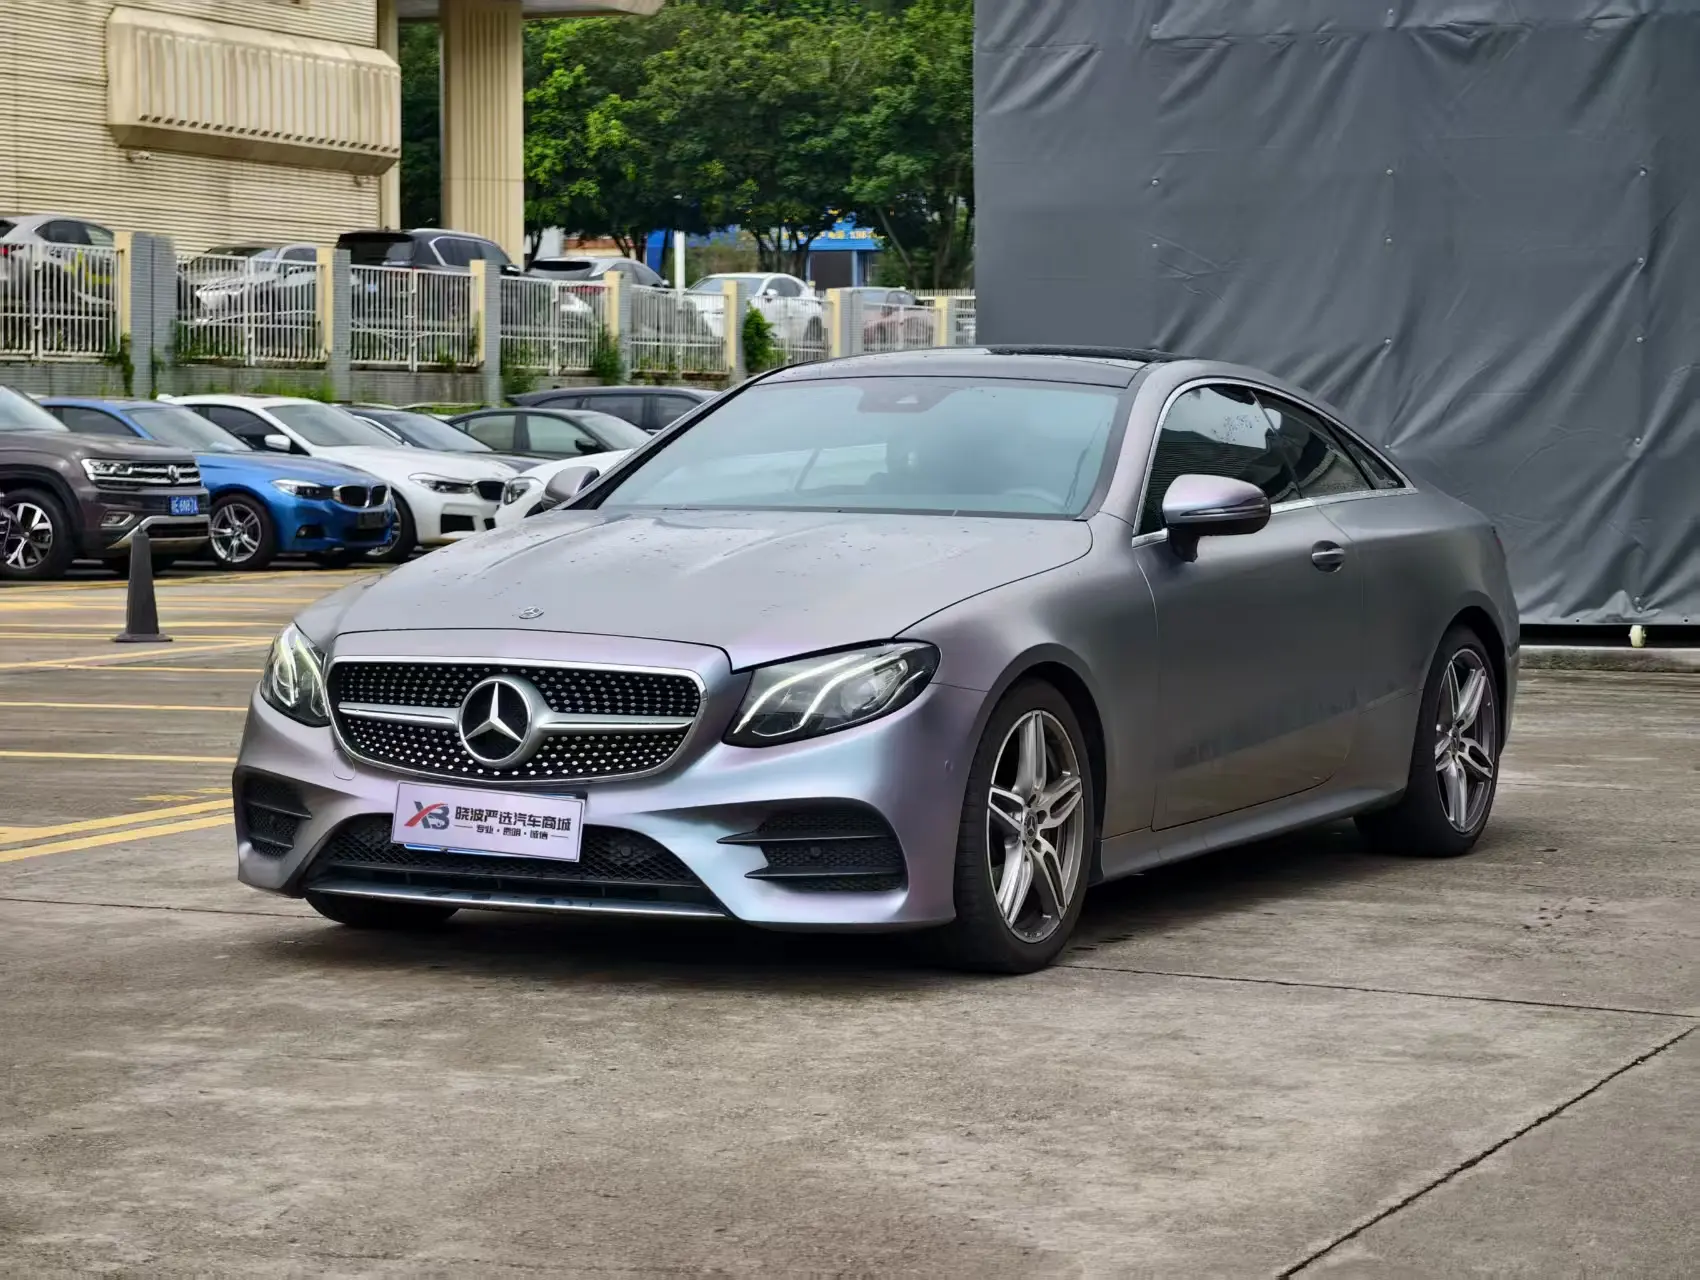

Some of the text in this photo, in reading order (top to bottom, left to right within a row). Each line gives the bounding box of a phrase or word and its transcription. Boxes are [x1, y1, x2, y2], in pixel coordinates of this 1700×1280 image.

[455, 806, 572, 832] 晓波严选汽车商城
